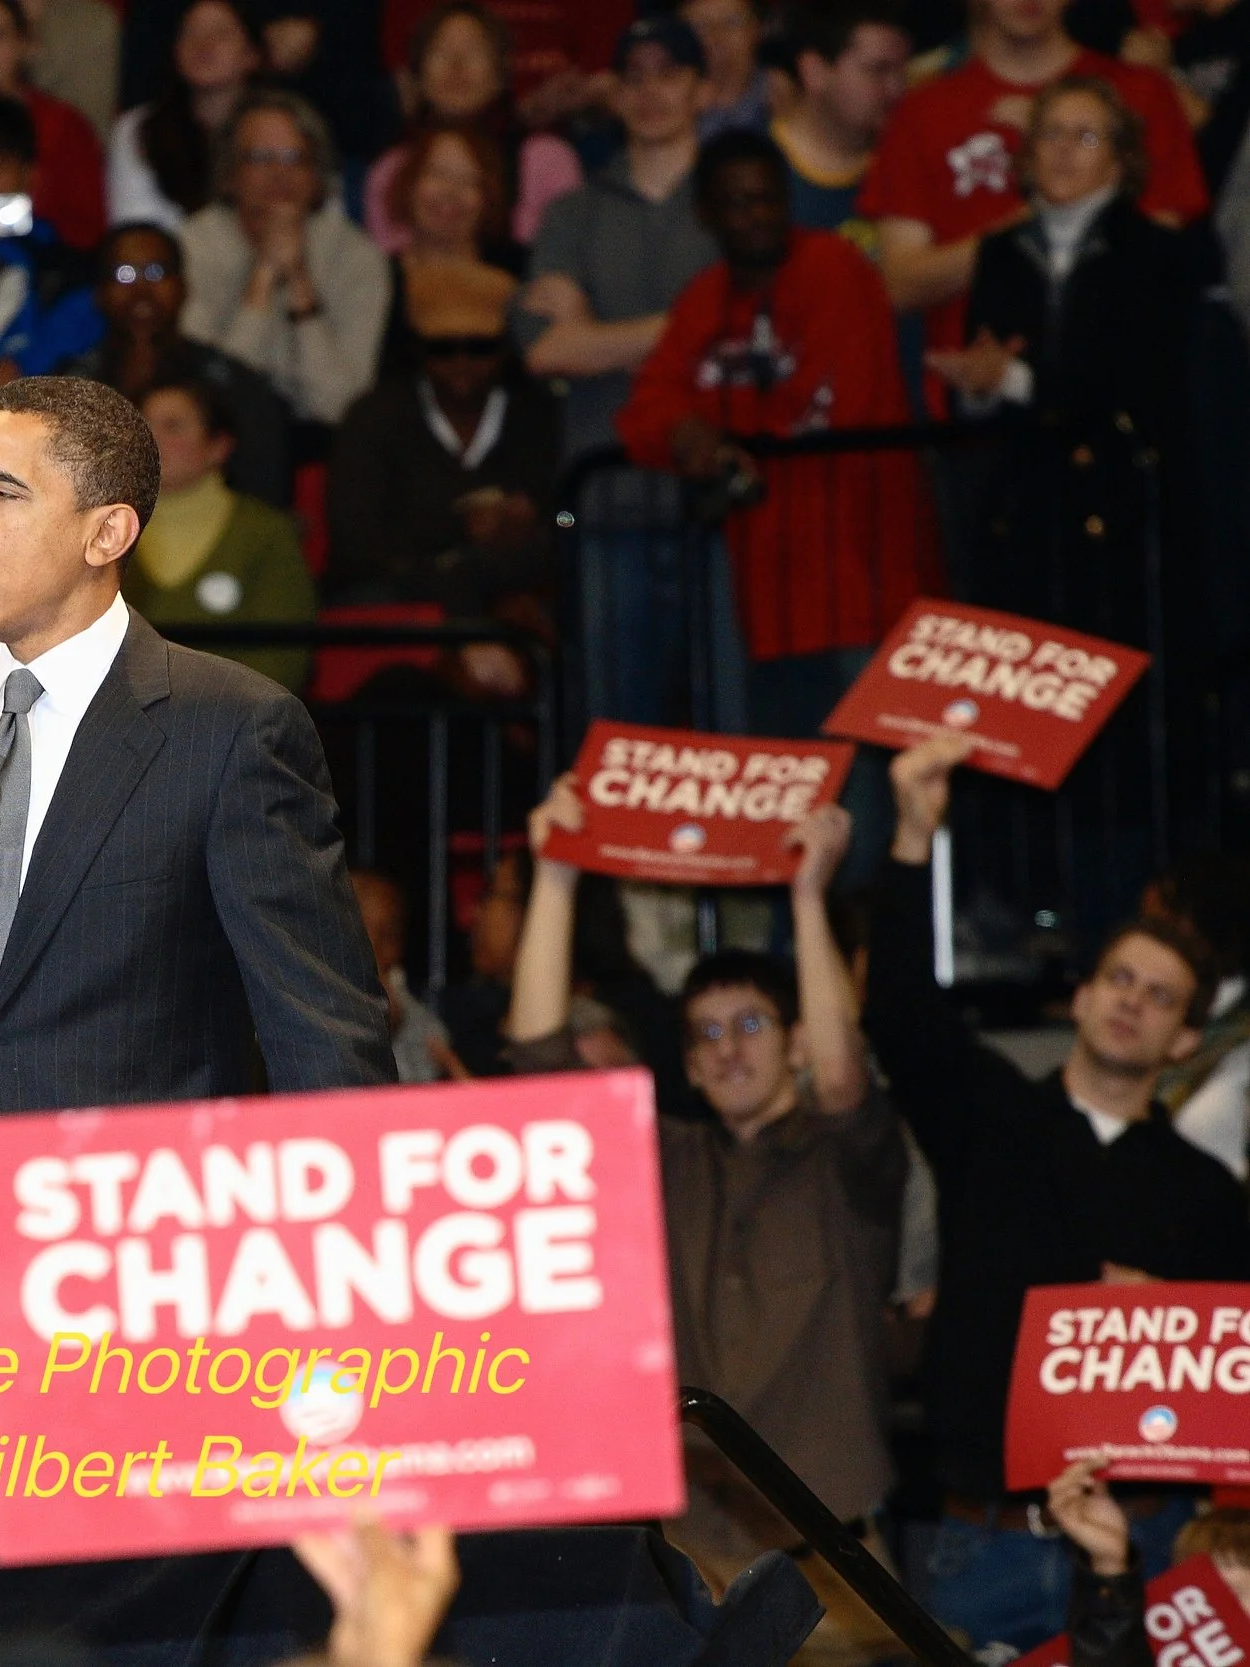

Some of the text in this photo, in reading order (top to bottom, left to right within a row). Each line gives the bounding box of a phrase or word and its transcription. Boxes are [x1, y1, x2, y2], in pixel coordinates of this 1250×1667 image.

[909, 613, 1118, 688] STAND FOR
[887, 642, 1099, 723] CHANGE
[602, 737, 830, 784] STAND FOR
[588, 768, 820, 823] CHANGE
[14, 1120, 596, 1240] STAND FOR
[21, 1204, 603, 1347] CHANGE
[1046, 1306, 1199, 1346] STAND
[1039, 1344, 1250, 1394] CHANG
[1144, 1585, 1216, 1641] OR
